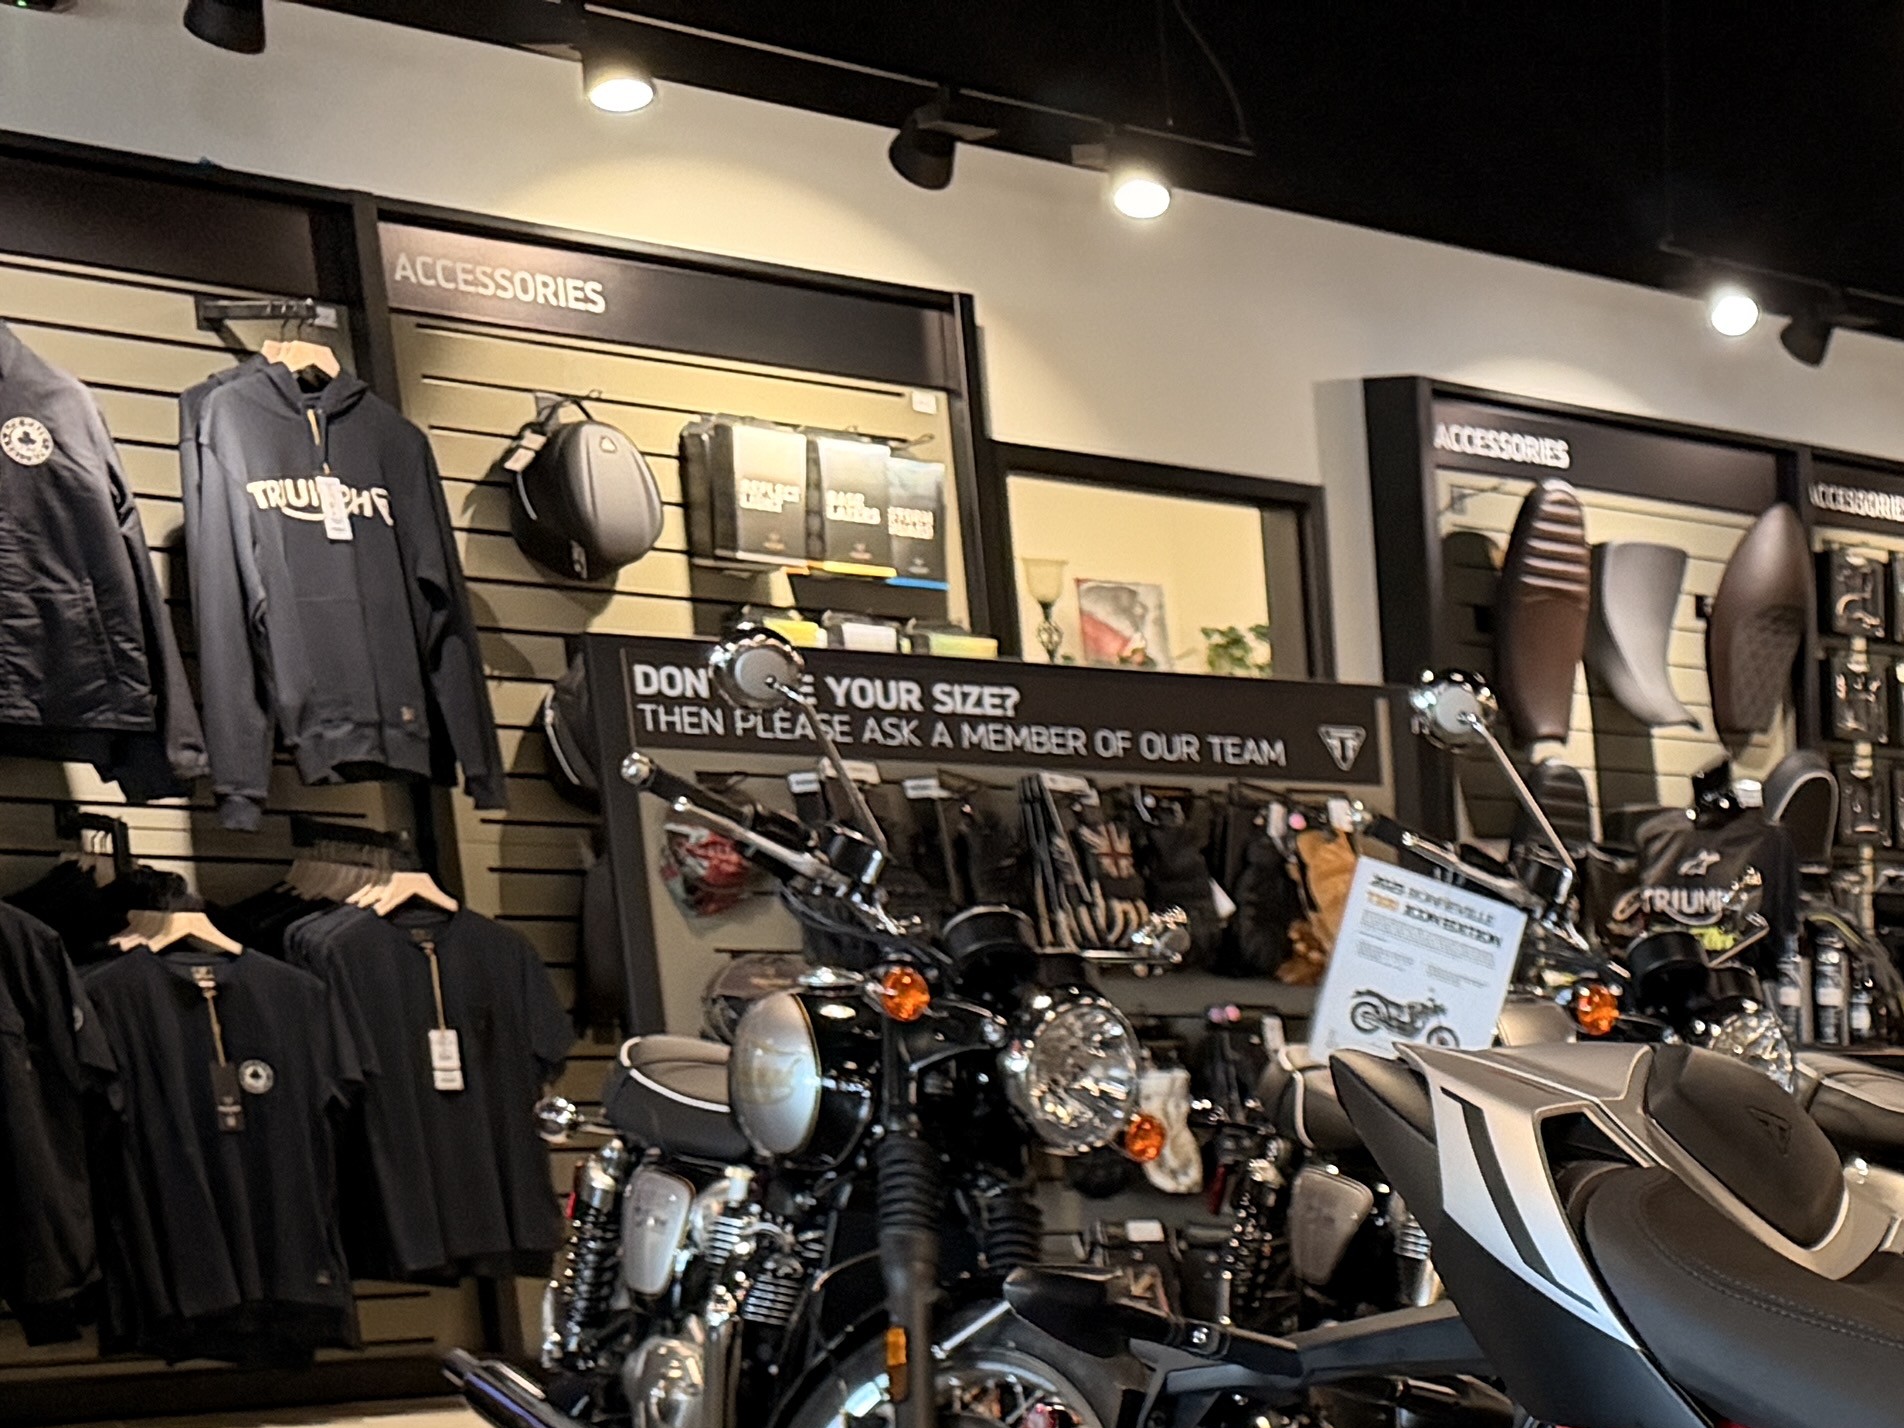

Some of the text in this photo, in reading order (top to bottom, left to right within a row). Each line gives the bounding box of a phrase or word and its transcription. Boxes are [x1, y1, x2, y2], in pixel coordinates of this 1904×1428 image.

[394, 252, 606, 314] ACCESSORIES
[1433, 421, 1571, 469] ACCESSORIES
[633, 663, 712, 699] DON'
[825, 675, 924, 712] YOUR
[933, 681, 1021, 718] SIZE?
[637, 703, 1288, 767] THEN PLEASE ASK A MEMBER OF OUR TEAM
